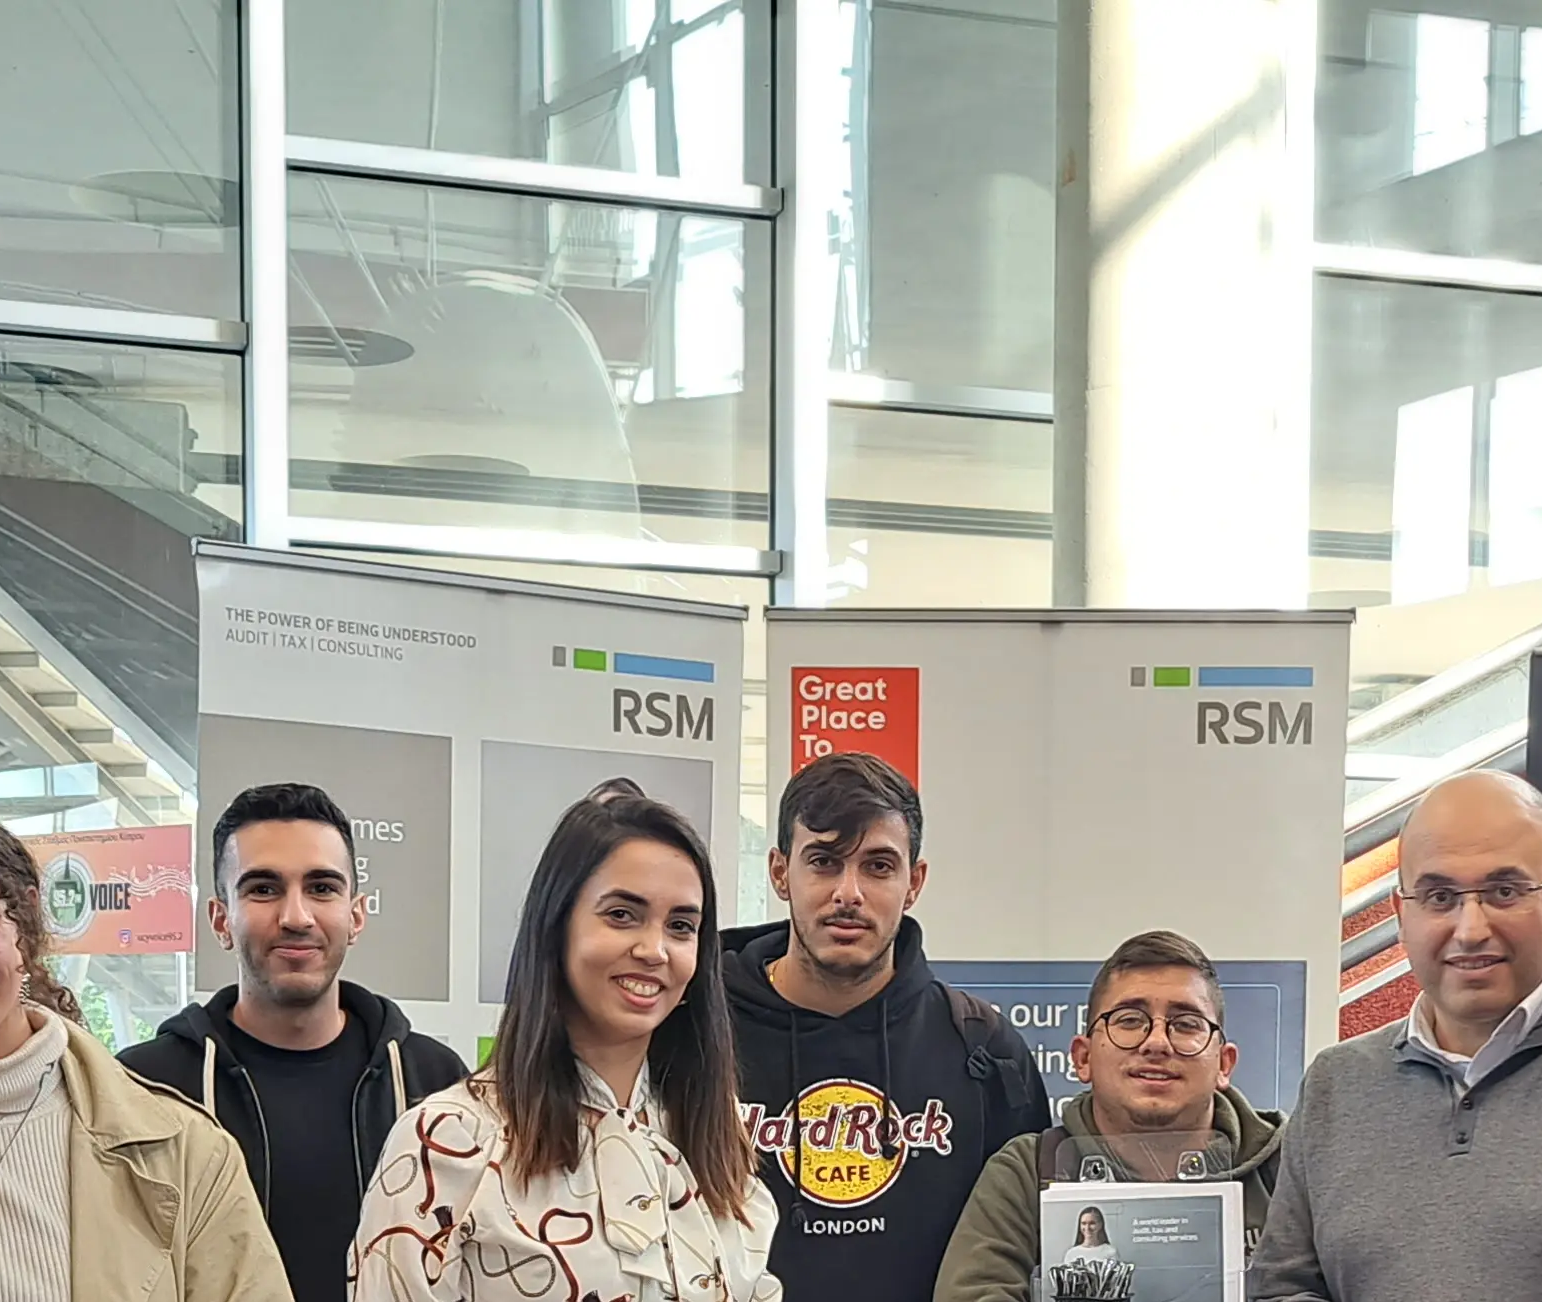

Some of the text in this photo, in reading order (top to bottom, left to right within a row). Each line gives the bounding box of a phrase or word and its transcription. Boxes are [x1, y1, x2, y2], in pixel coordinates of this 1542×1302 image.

[224, 606, 477, 649] THE POWER OF BEING UNDERSTOOD
[224, 627, 404, 661] AUDIT TAX CONSULTING
[799, 674, 888, 701] Great
[613, 687, 715, 742] RSM
[801, 704, 887, 730] Place
[1196, 701, 1314, 746] RSM
[799, 734, 834, 758] To
[89, 883, 132, 911] VOICE
[1009, 1003, 1070, 1028] our
[843, 1100, 952, 1157] Rock
[814, 1164, 872, 1184] CAFE
[803, 1216, 885, 1236] LONDON
